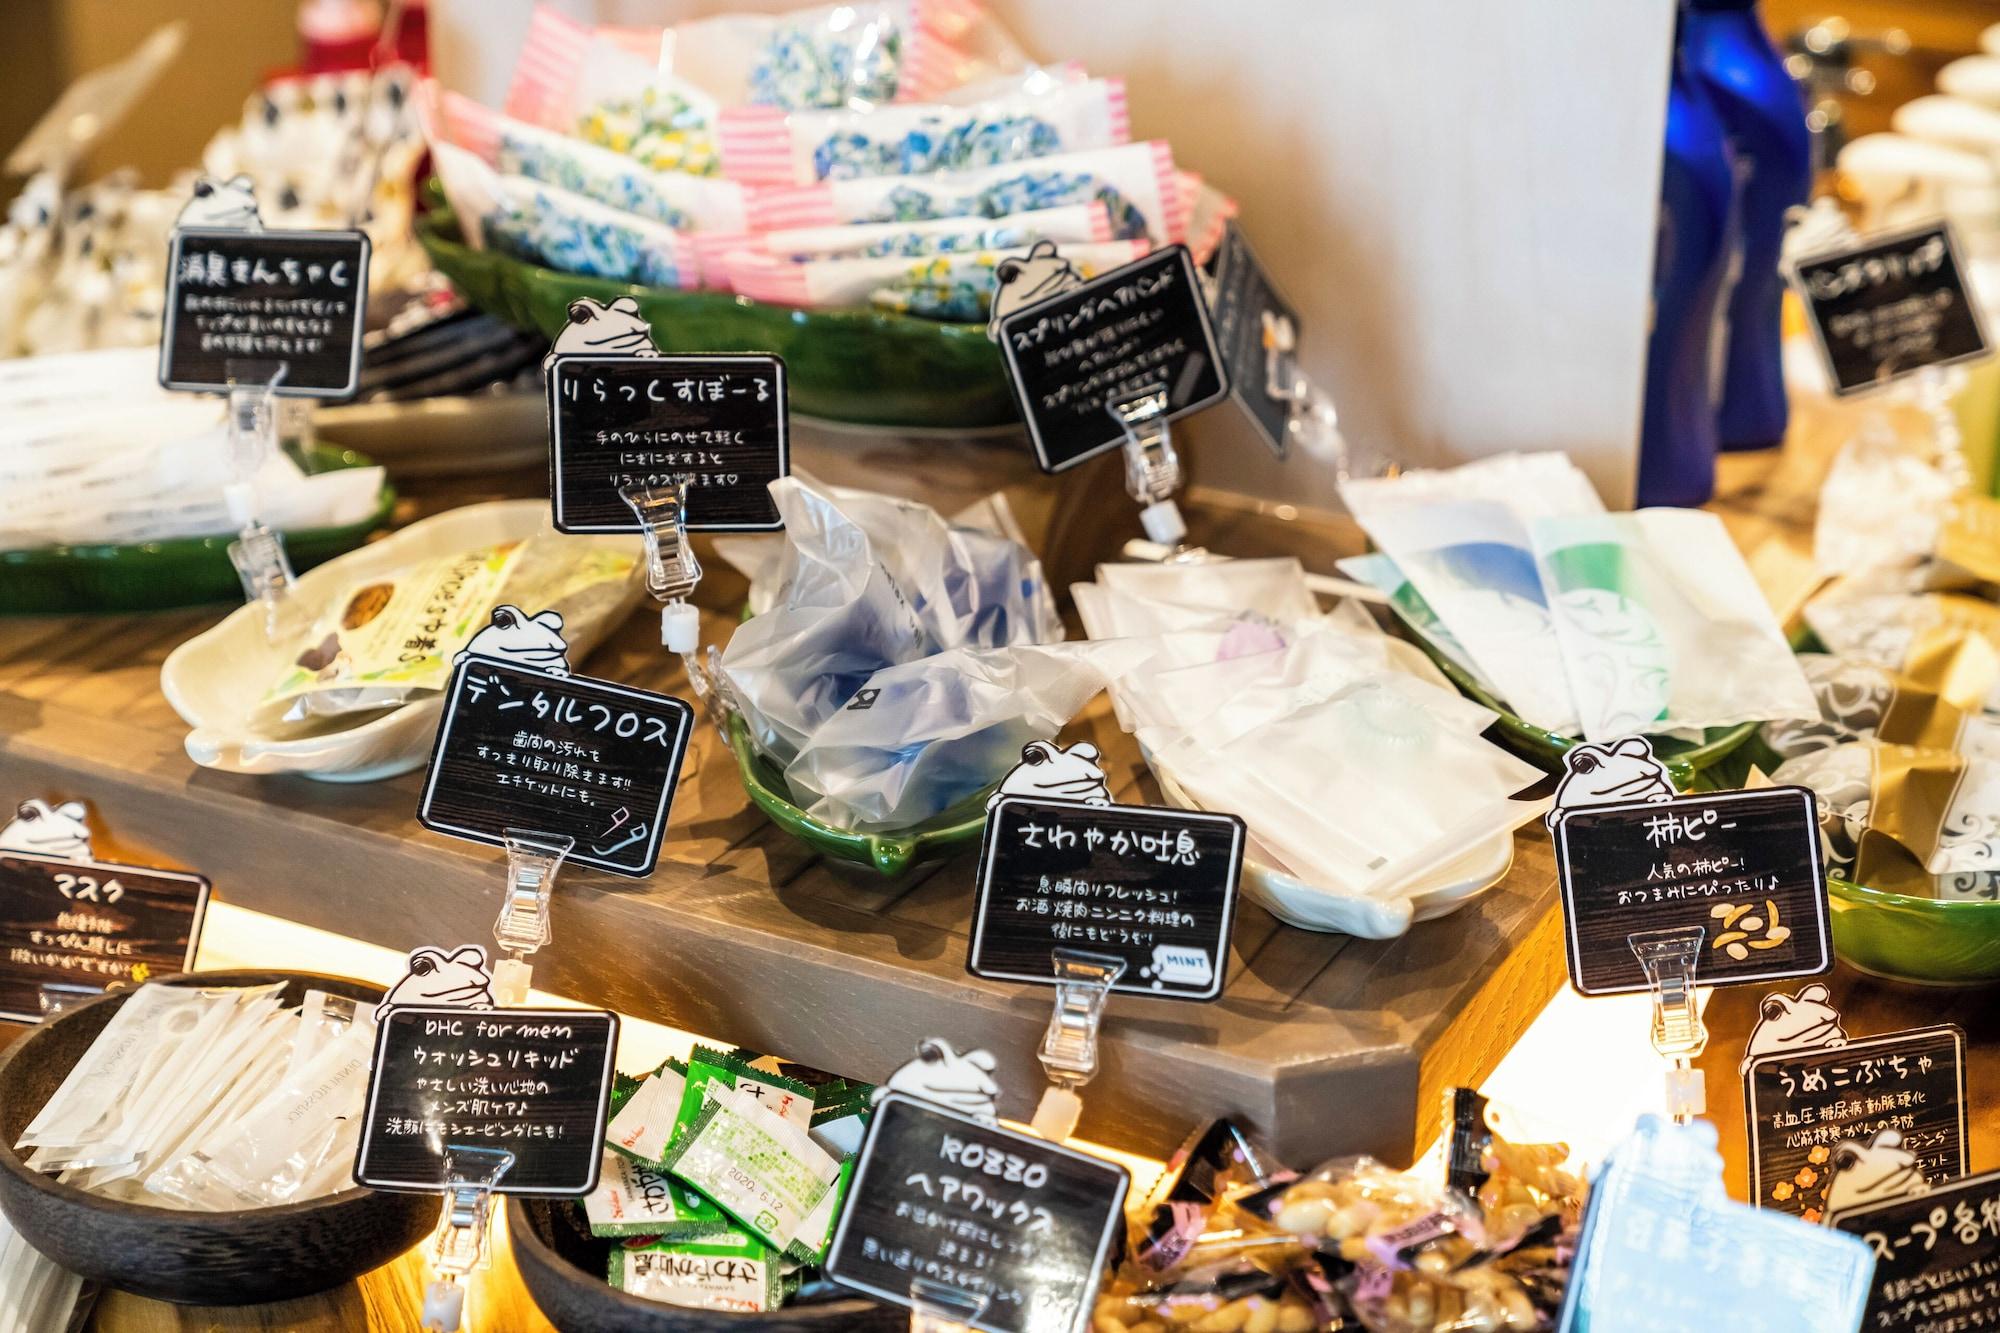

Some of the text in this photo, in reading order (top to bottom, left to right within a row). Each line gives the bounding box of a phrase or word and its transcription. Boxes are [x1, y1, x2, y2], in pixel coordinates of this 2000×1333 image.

[564, 375, 771, 402] りらっくすぼーる
[596, 430, 745, 446] 手のひらにのせて軽く
[620, 451, 724, 466] にぎにぎすると
[465, 674, 667, 747] デンタルフロス
[512, 730, 601, 763] 歯間の汚れを
[1643, 809, 1737, 848] 柿ピー
[1017, 822, 1200, 866] さわやか吐息
[1646, 857, 1746, 881] 人気の柿ピー!
[53, 873, 125, 904] マスク
[1166, 953, 1205, 969] MINT
[424, 1020, 573, 1039] DHC for men
[416, 1077, 550, 1096] やさしい洗い心地の
[1779, 1055, 1933, 1098] うめこぶちゃ
